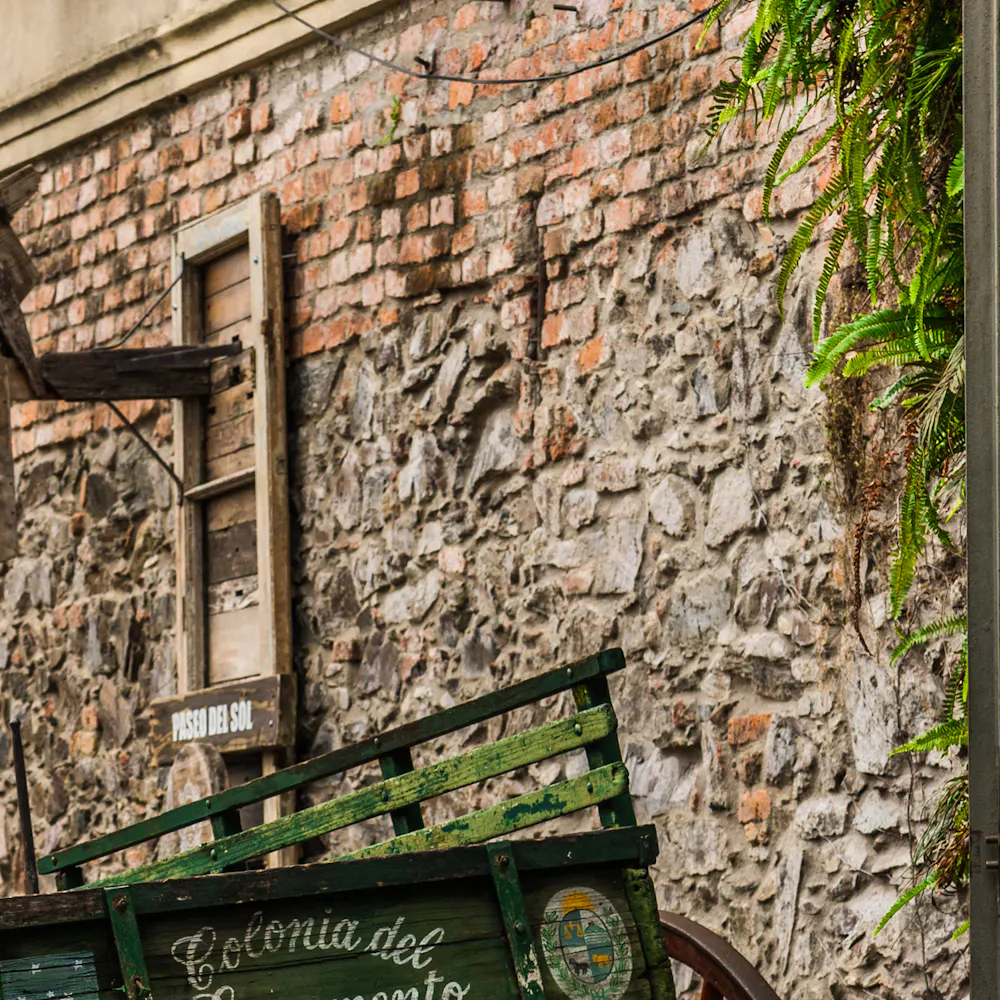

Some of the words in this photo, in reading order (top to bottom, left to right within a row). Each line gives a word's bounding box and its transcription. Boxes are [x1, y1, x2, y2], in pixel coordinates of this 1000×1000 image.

[171, 707, 207, 742] PASEO
[208, 704, 229, 736] DEL
[230, 700, 253, 733] SOL
[171, 908, 362, 990] Colonia
[364, 916, 445, 969] del
